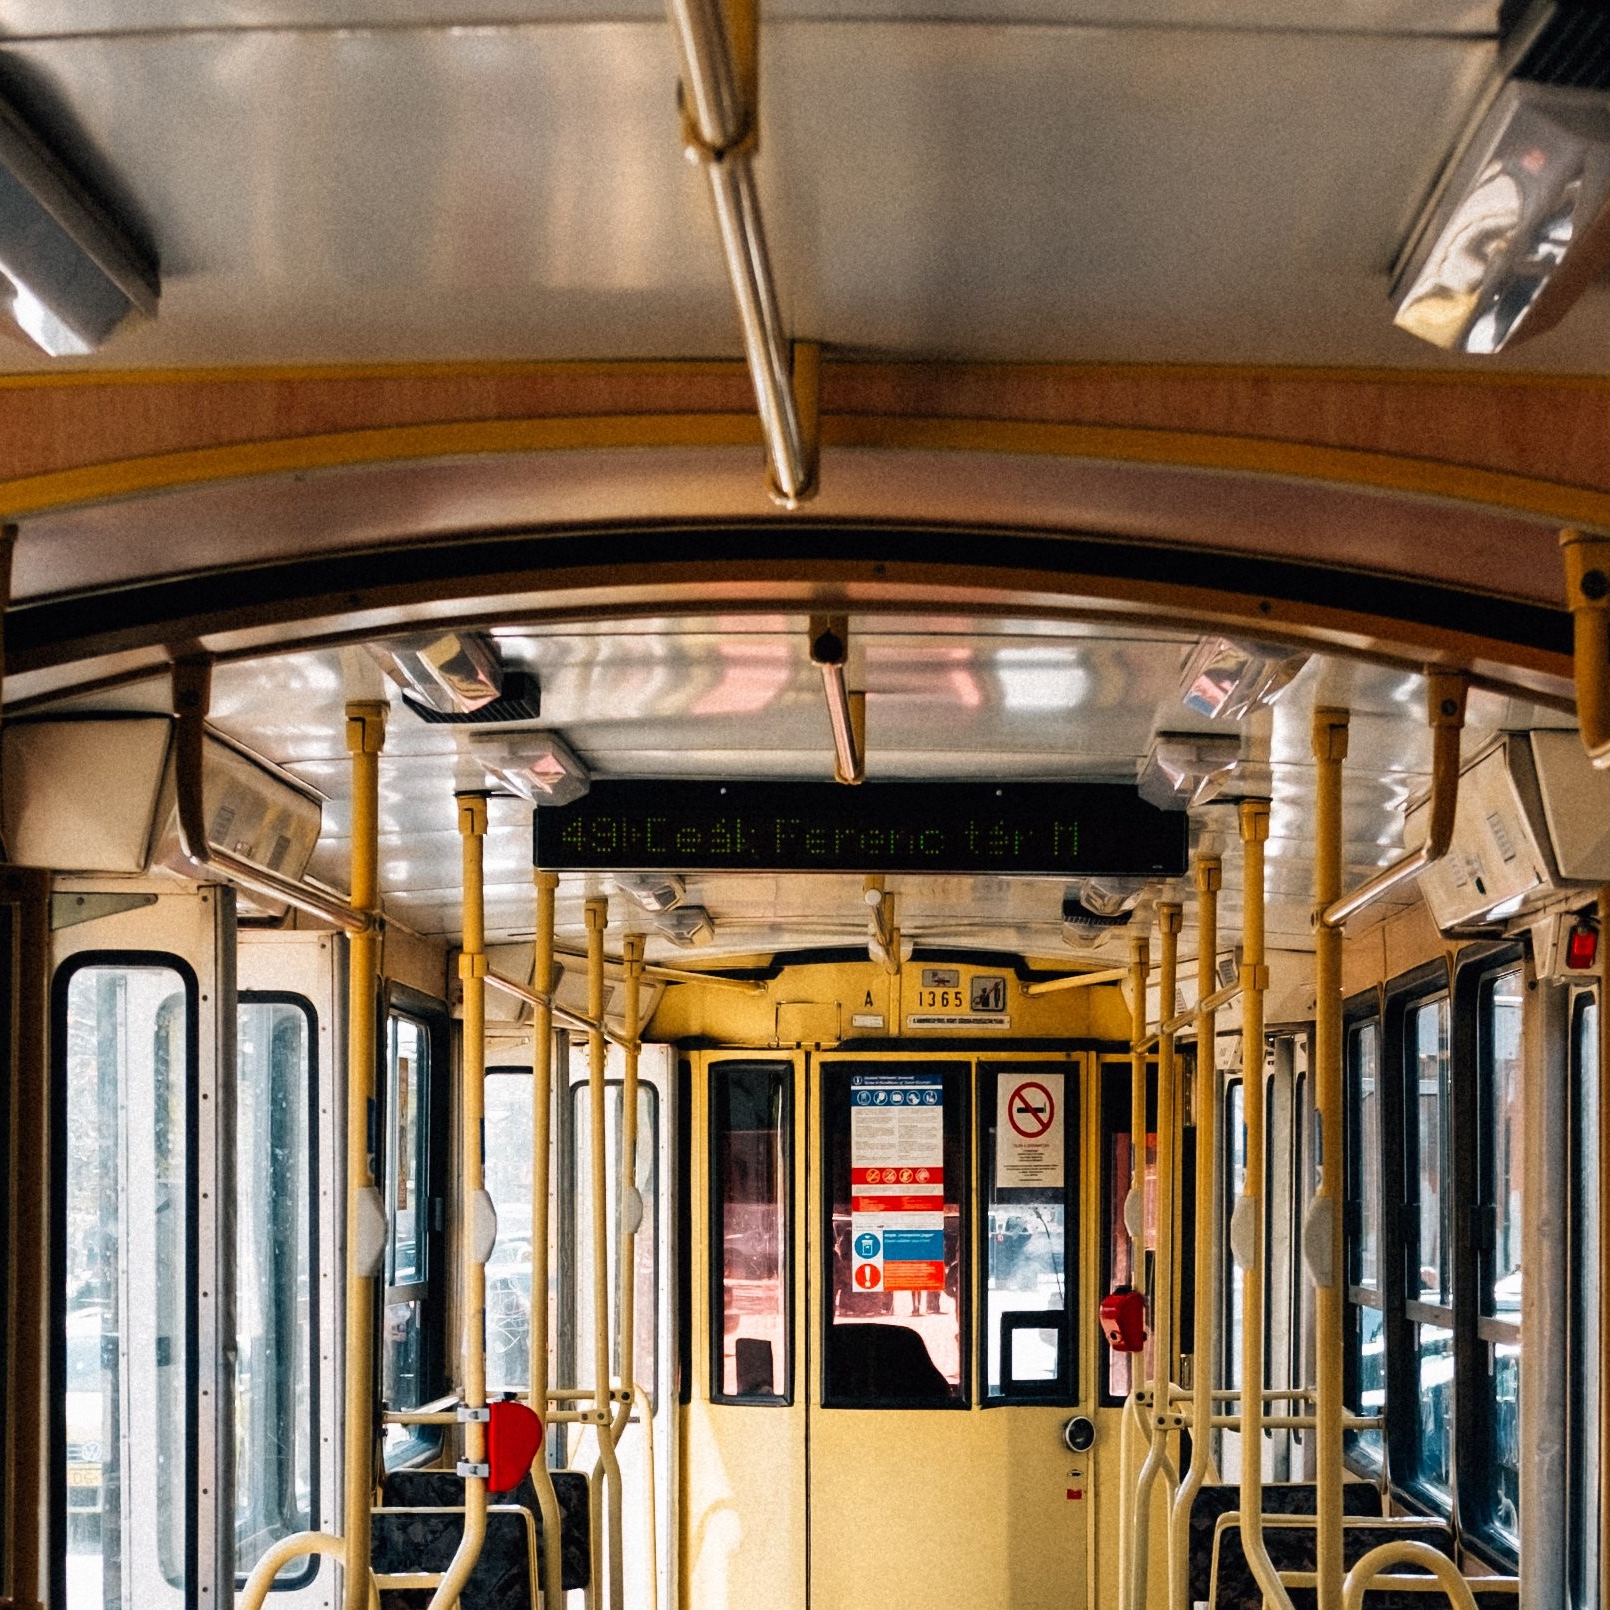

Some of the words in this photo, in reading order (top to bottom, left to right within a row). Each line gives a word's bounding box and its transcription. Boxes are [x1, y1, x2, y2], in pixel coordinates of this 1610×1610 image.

[562, 817, 617, 852] 49
[776, 818, 945, 854] Ferenc
[964, 819, 1033, 855] tér
[864, 989, 874, 1007] A
[918, 991, 963, 1007] 1365
